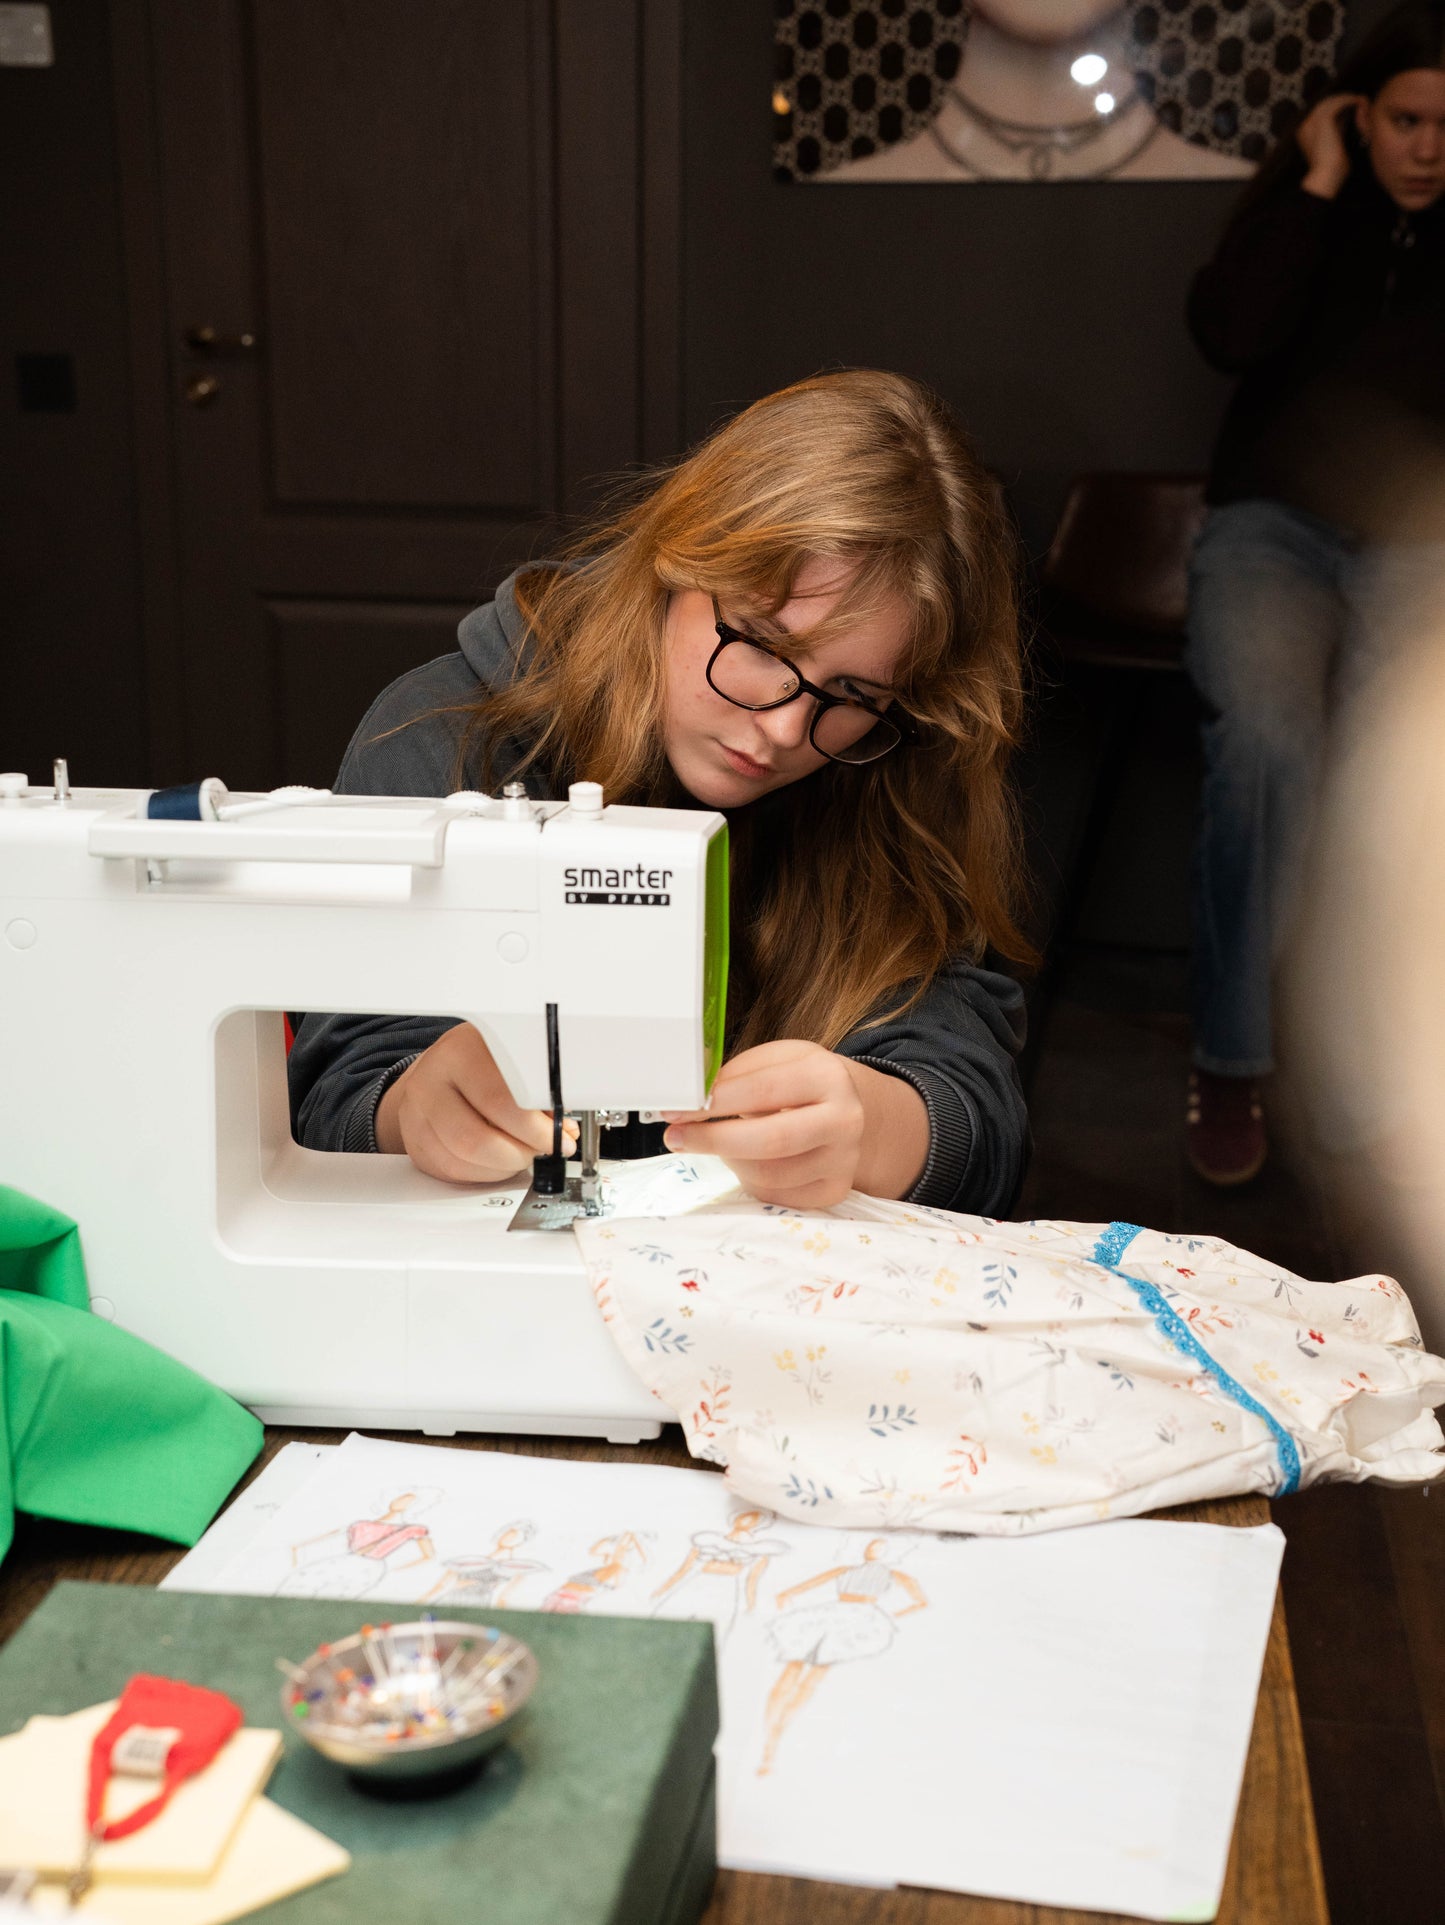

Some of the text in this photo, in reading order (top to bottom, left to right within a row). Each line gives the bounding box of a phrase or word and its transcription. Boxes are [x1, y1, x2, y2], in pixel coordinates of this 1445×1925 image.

[564, 863, 673, 889] smarter
[567, 893, 668, 905] BY PFAFF
